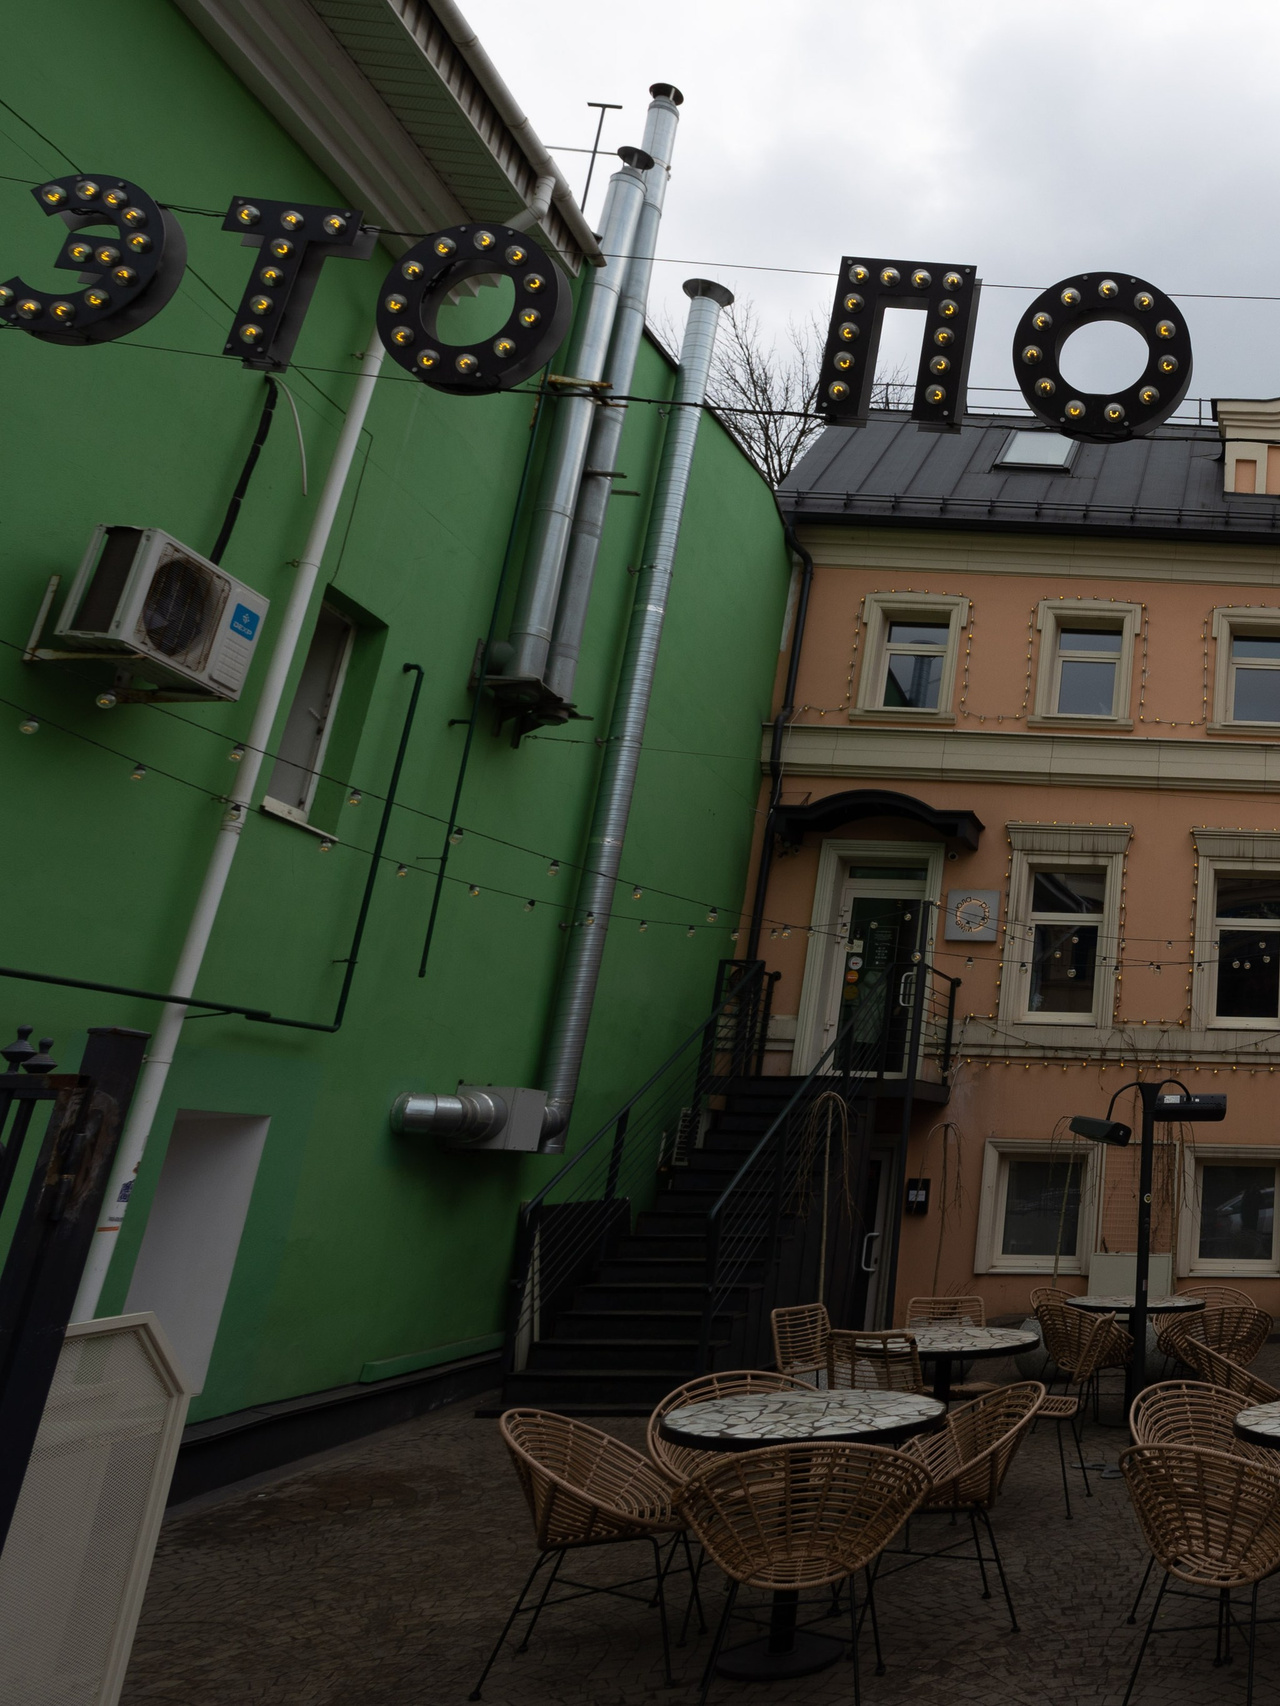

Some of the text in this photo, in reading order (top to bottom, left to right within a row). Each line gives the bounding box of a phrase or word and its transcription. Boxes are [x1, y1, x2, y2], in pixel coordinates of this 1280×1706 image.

[0, 173, 573, 396] ЭТО
[818, 256, 1192, 444] ПО
[233, 621, 252, 635] DEXP
[955, 896, 972, 909] юла
